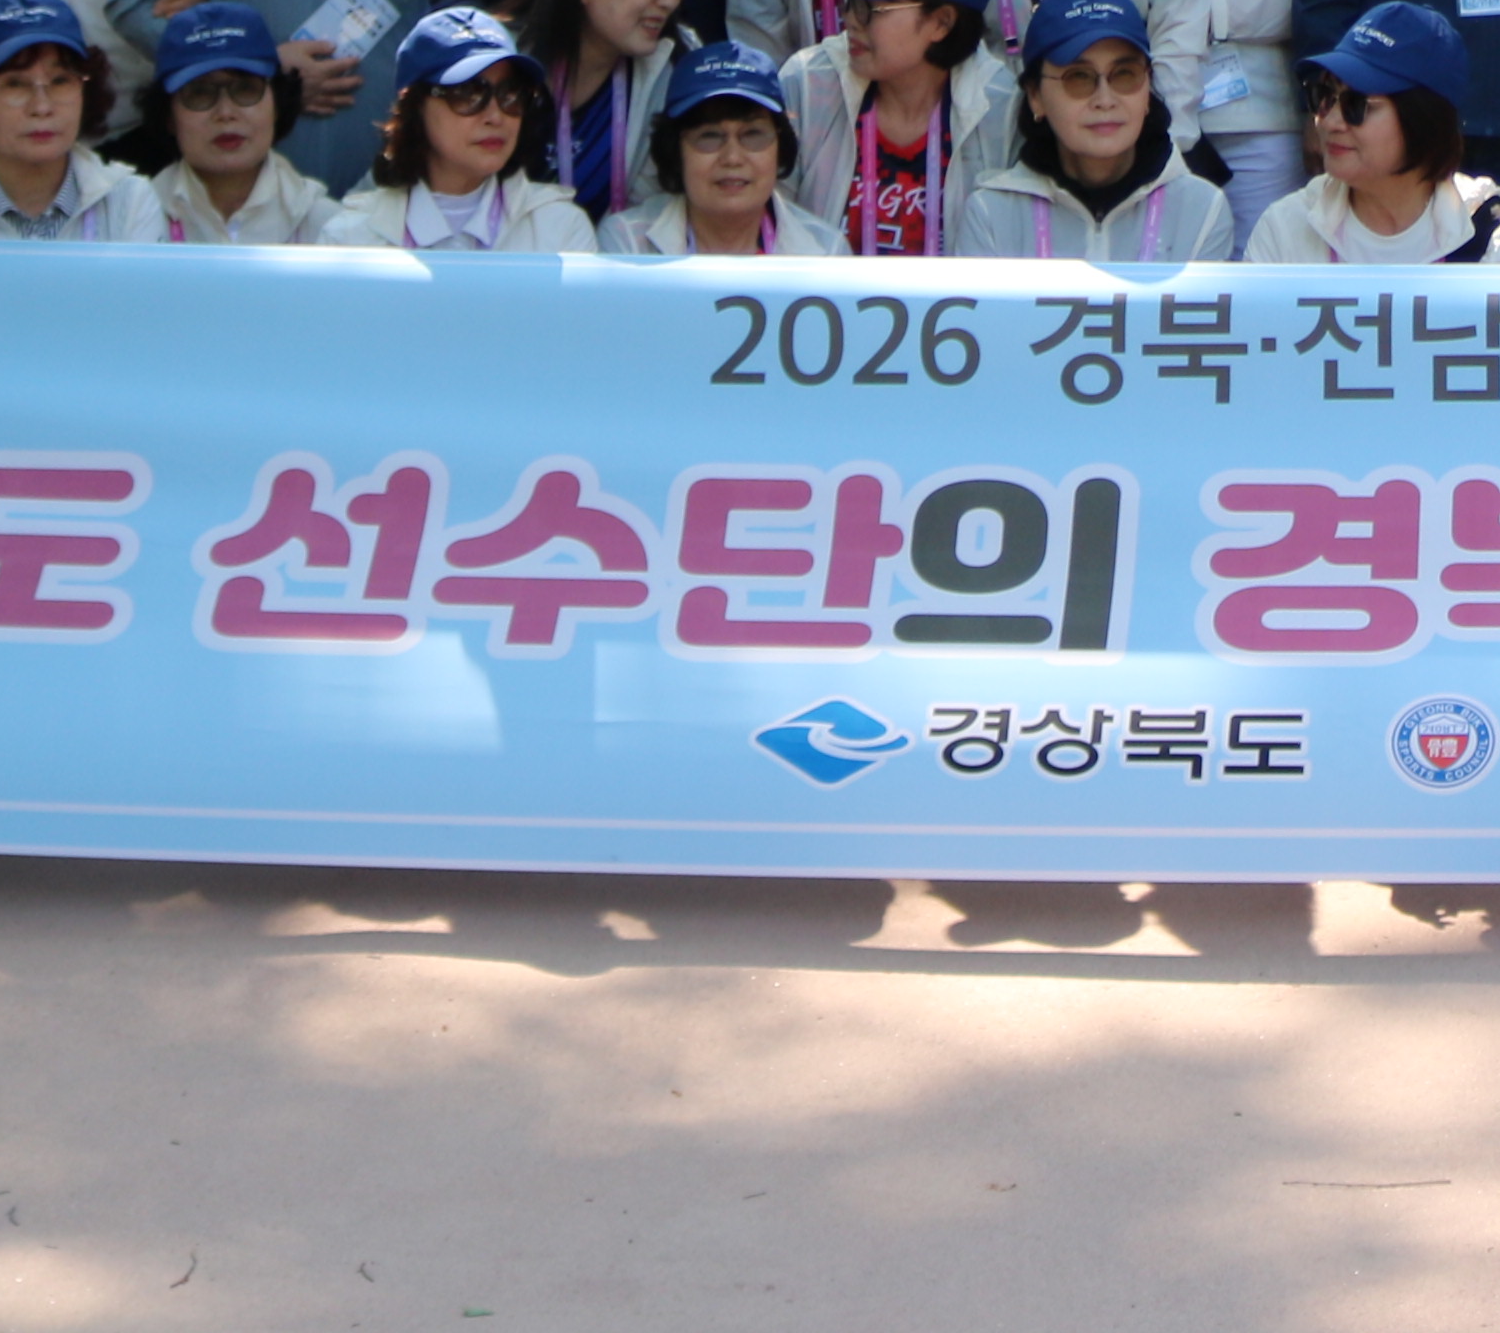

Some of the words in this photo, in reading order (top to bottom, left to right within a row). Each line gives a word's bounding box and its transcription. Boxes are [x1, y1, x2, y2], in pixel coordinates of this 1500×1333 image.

[711, 295, 981, 385] 2026
[211, 466, 1122, 650] 선수단의
[930, 709, 1306, 780] 경상북도
